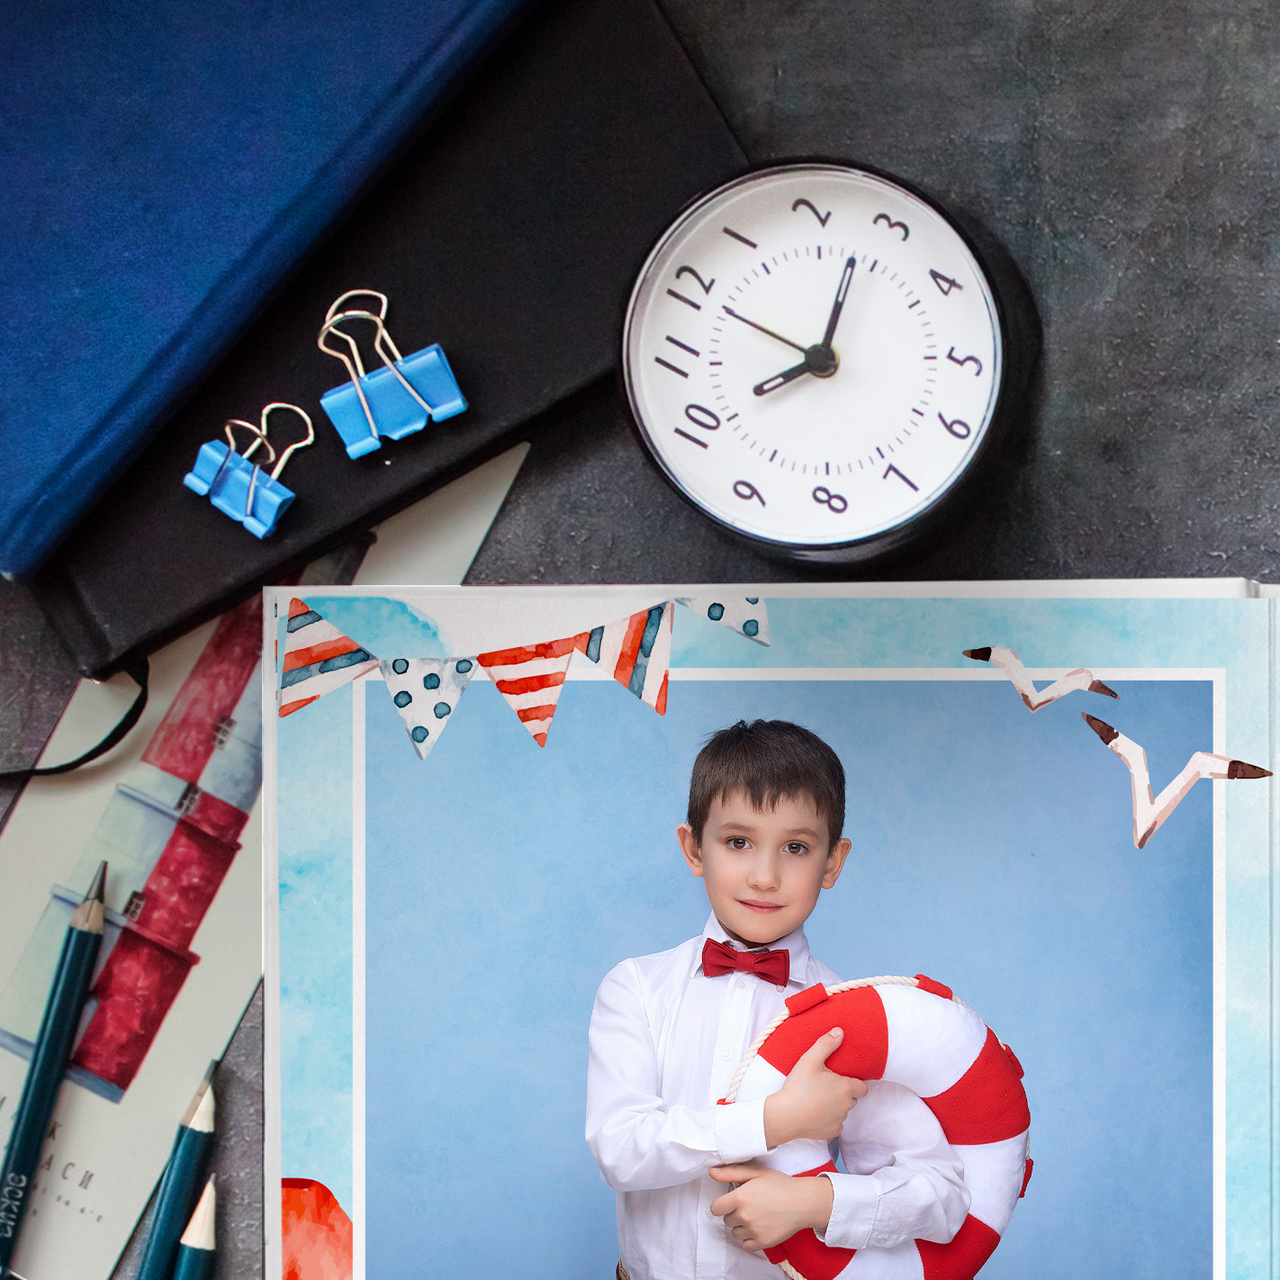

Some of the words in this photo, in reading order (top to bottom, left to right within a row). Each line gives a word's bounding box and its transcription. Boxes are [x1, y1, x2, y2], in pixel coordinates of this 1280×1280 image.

[791, 198, 831, 228] 2
[873, 213, 910, 242] 3
[723, 227, 757, 249] 1
[667, 265, 715, 310] 12
[929, 268, 964, 296] 4
[654, 335, 700, 378] 11
[946, 346, 982, 377] 5
[674, 404, 720, 449] 10
[937, 412, 970, 440] 6
[883, 463, 919, 492] 7
[733, 480, 766, 507] 9
[812, 486, 848, 513] 8
